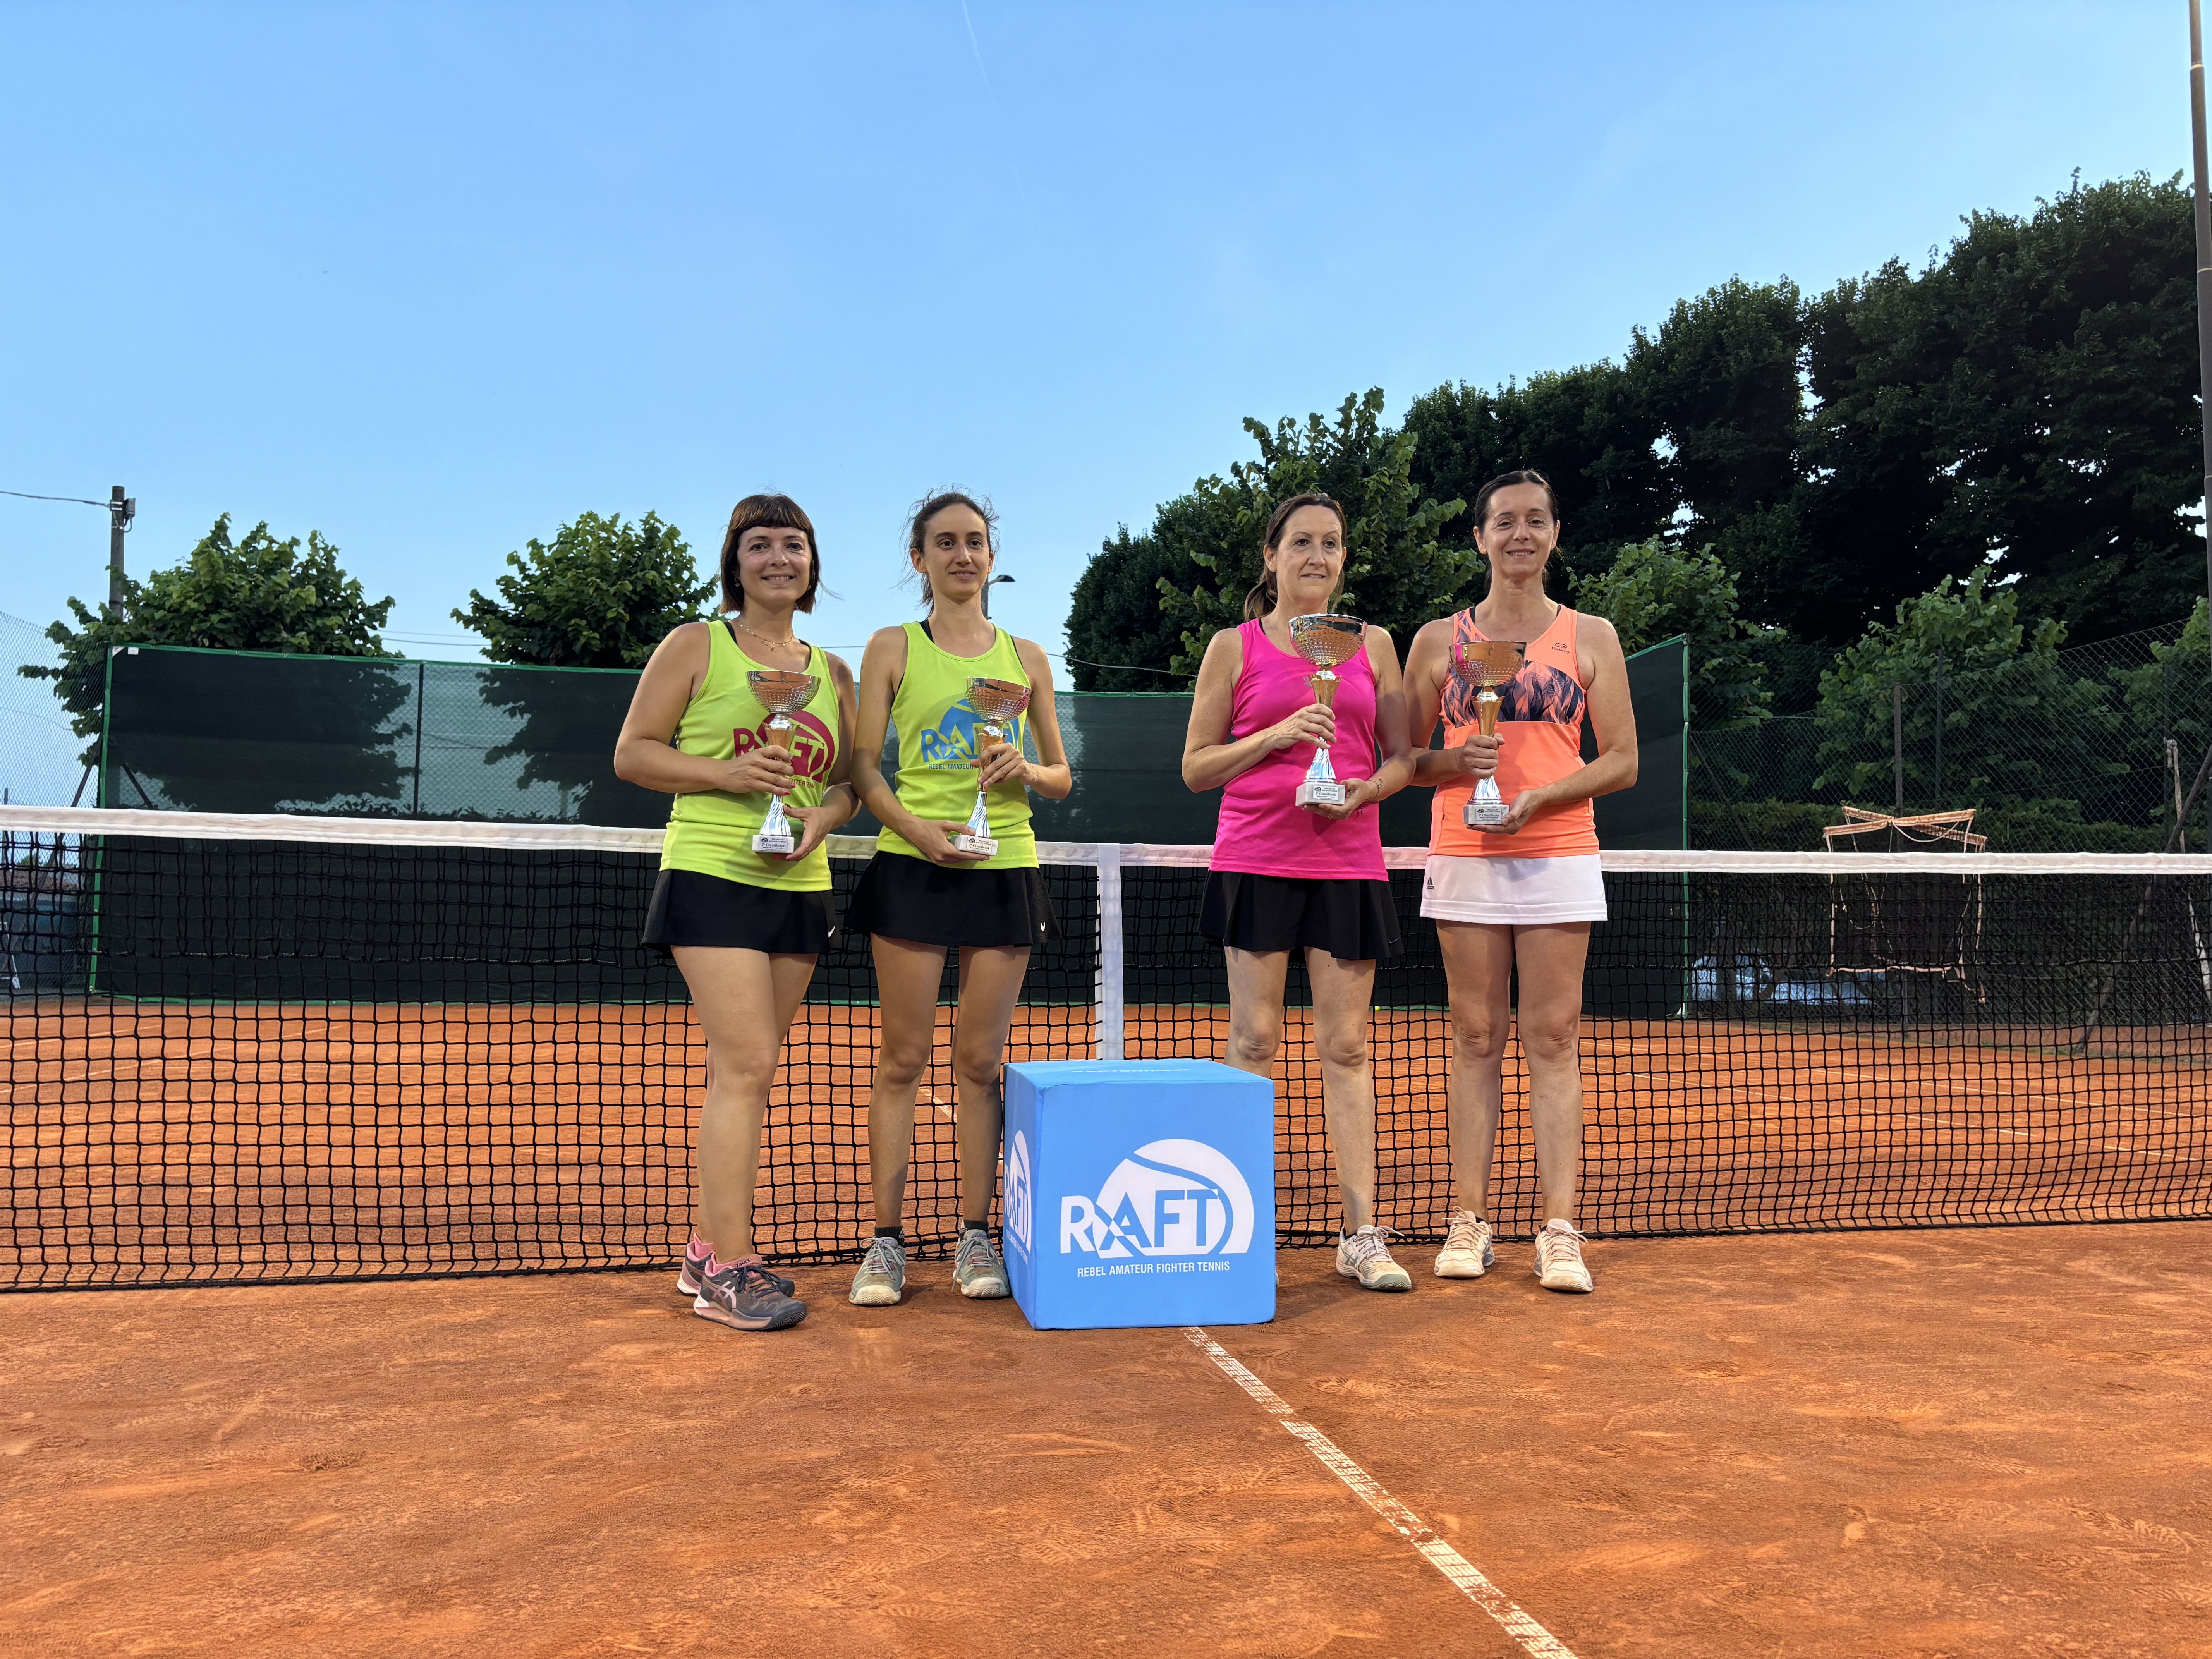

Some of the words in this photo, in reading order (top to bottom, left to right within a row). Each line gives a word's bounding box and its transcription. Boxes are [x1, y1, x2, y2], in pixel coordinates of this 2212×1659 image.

[1060, 1188, 1218, 1254] RAFT
[1077, 1266, 1107, 1278] REBEL
[1109, 1264, 1154, 1275] AMATEUR
[1156, 1262, 1195, 1273] FIGHTER
[1197, 1261, 1230, 1272] TENNIS
